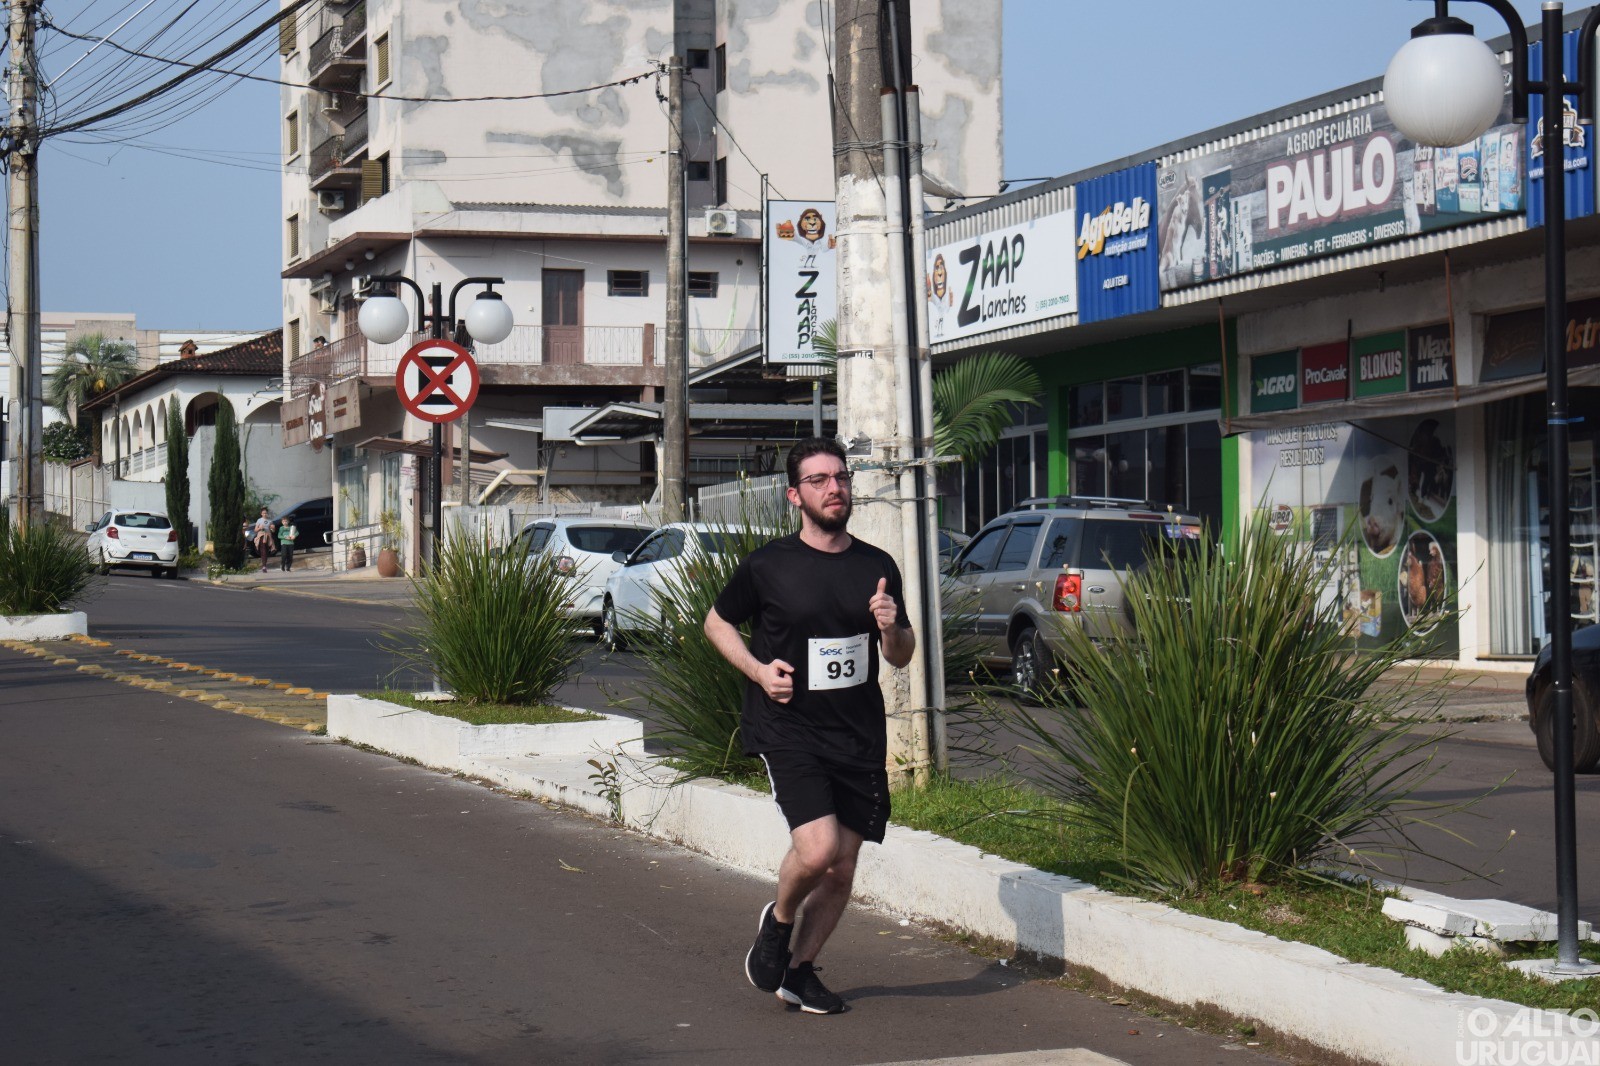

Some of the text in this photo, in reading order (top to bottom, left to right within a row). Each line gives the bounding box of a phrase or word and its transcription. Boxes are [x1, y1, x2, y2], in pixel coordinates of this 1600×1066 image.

[1286, 113, 1373, 157] AGROPECUÁRIA
[1268, 136, 1395, 230] PAULO
[1077, 197, 1151, 251] AgroBella
[1253, 220, 1405, 267] RAÇÕES MINERAIS PET FERRAGENS DIVERSOS
[957, 233, 1025, 328] ZAAP
[795, 271, 820, 349] ZAAP
[982, 289, 1026, 323] Lanches
[1257, 374, 1295, 396] AGRO
[1360, 350, 1402, 381] BLOKUS
[1417, 358, 1448, 384] milk
[1267, 428, 1283, 445] MAIS
[827, 659, 855, 680] 93
